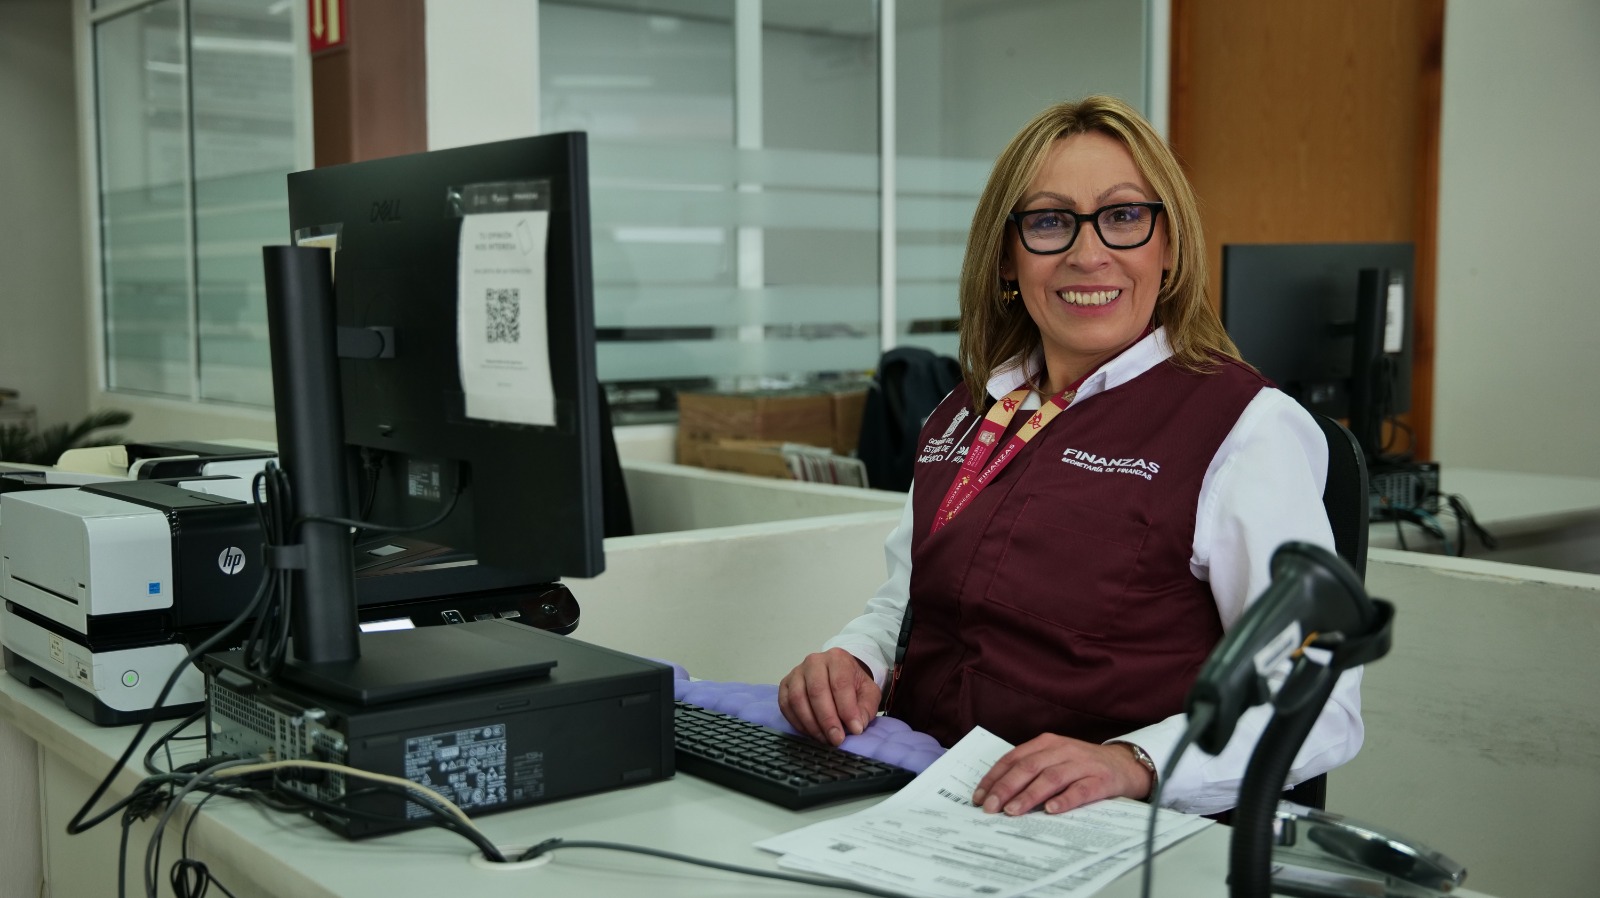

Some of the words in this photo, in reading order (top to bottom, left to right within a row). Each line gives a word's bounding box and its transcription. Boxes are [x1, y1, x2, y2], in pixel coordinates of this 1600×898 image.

[370, 199, 402, 223] DELL
[978, 444, 1015, 483] FINANZAS
[1061, 457, 1103, 473] SECRETARÍA
[1116, 468, 1152, 481] FINANZAS
[1062, 448, 1160, 474] FINANZAS
[221, 546, 243, 575] hp
